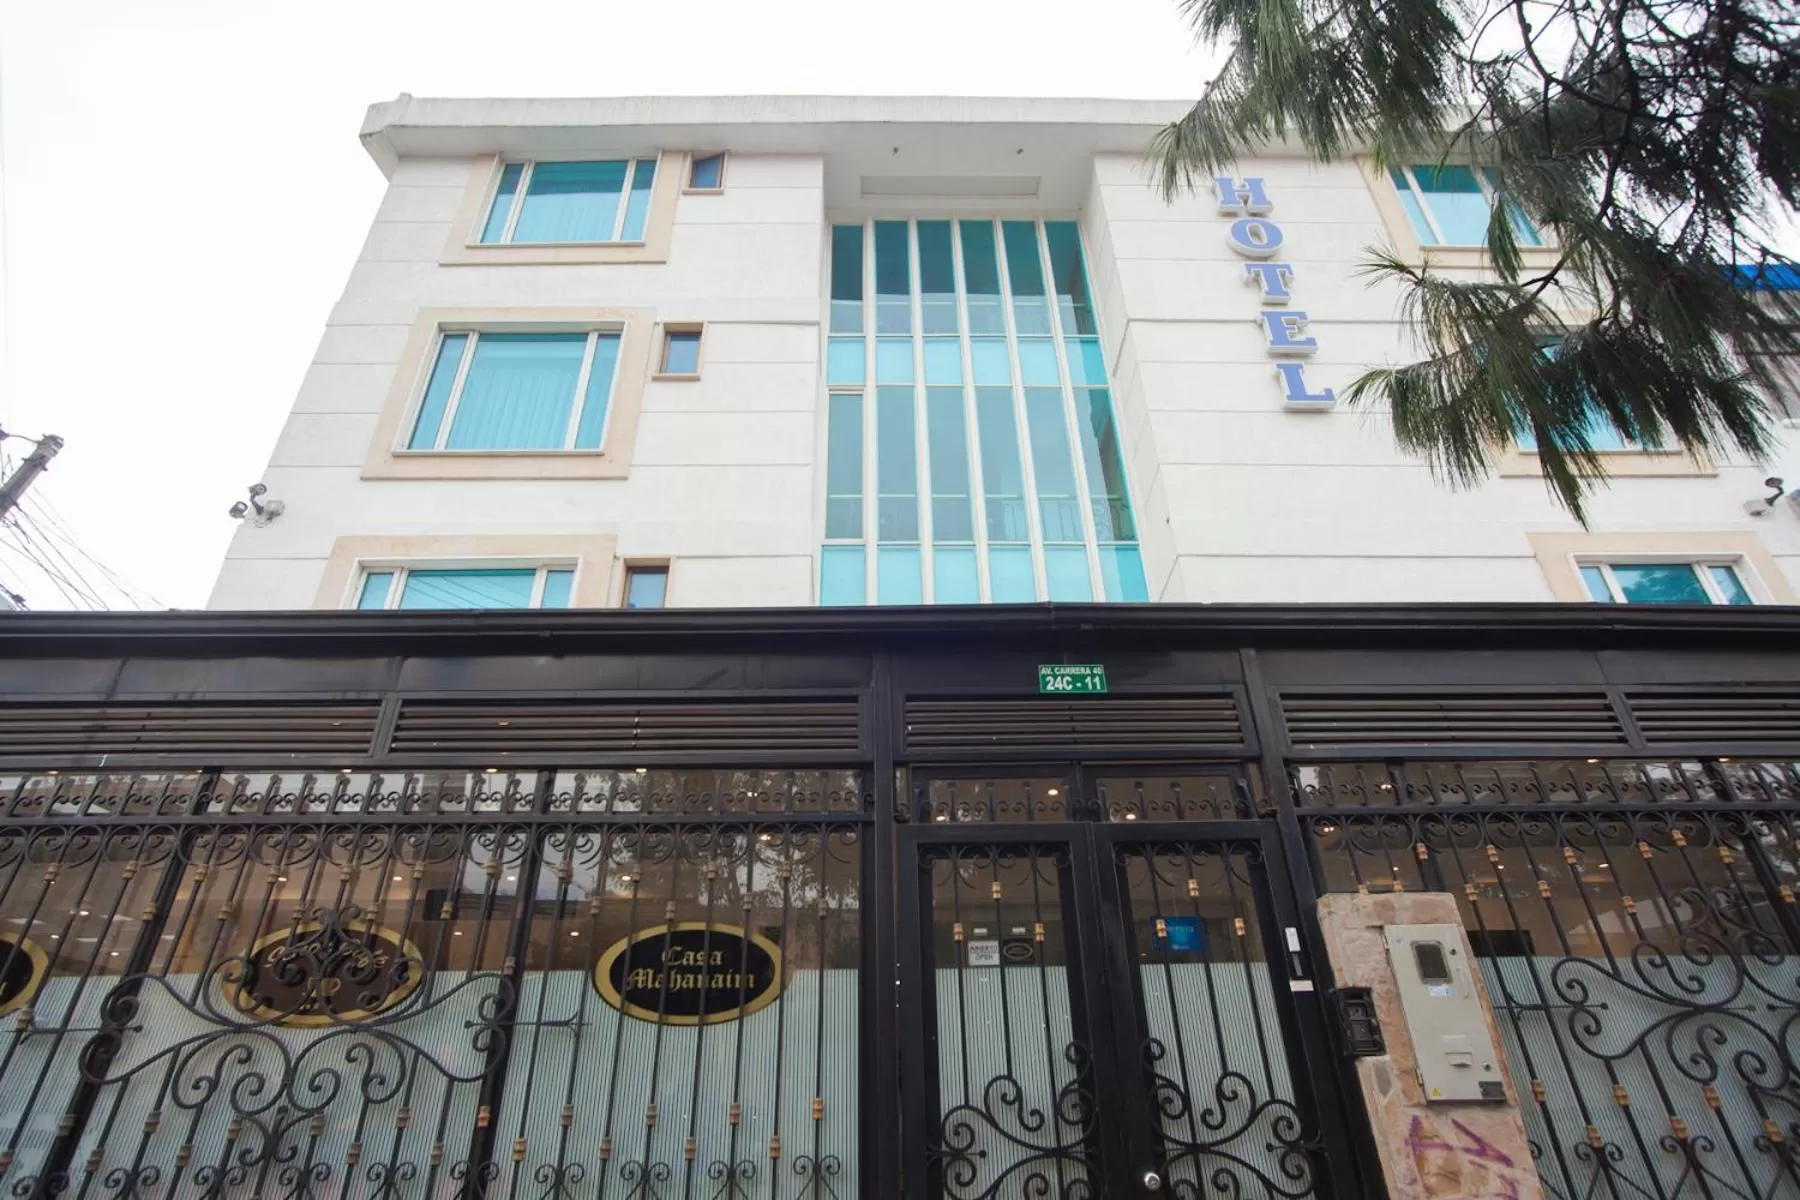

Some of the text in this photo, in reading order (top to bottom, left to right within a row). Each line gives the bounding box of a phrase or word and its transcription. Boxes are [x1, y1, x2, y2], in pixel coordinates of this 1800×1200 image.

[1213, 176, 1336, 408] HOTEL
[1041, 666, 1053, 675] AV.
[1054, 666, 1091, 675] CARRERA
[1046, 675, 1073, 690] 24C
[1085, 675, 1101, 690] 11
[661, 946, 724, 966] Casa
